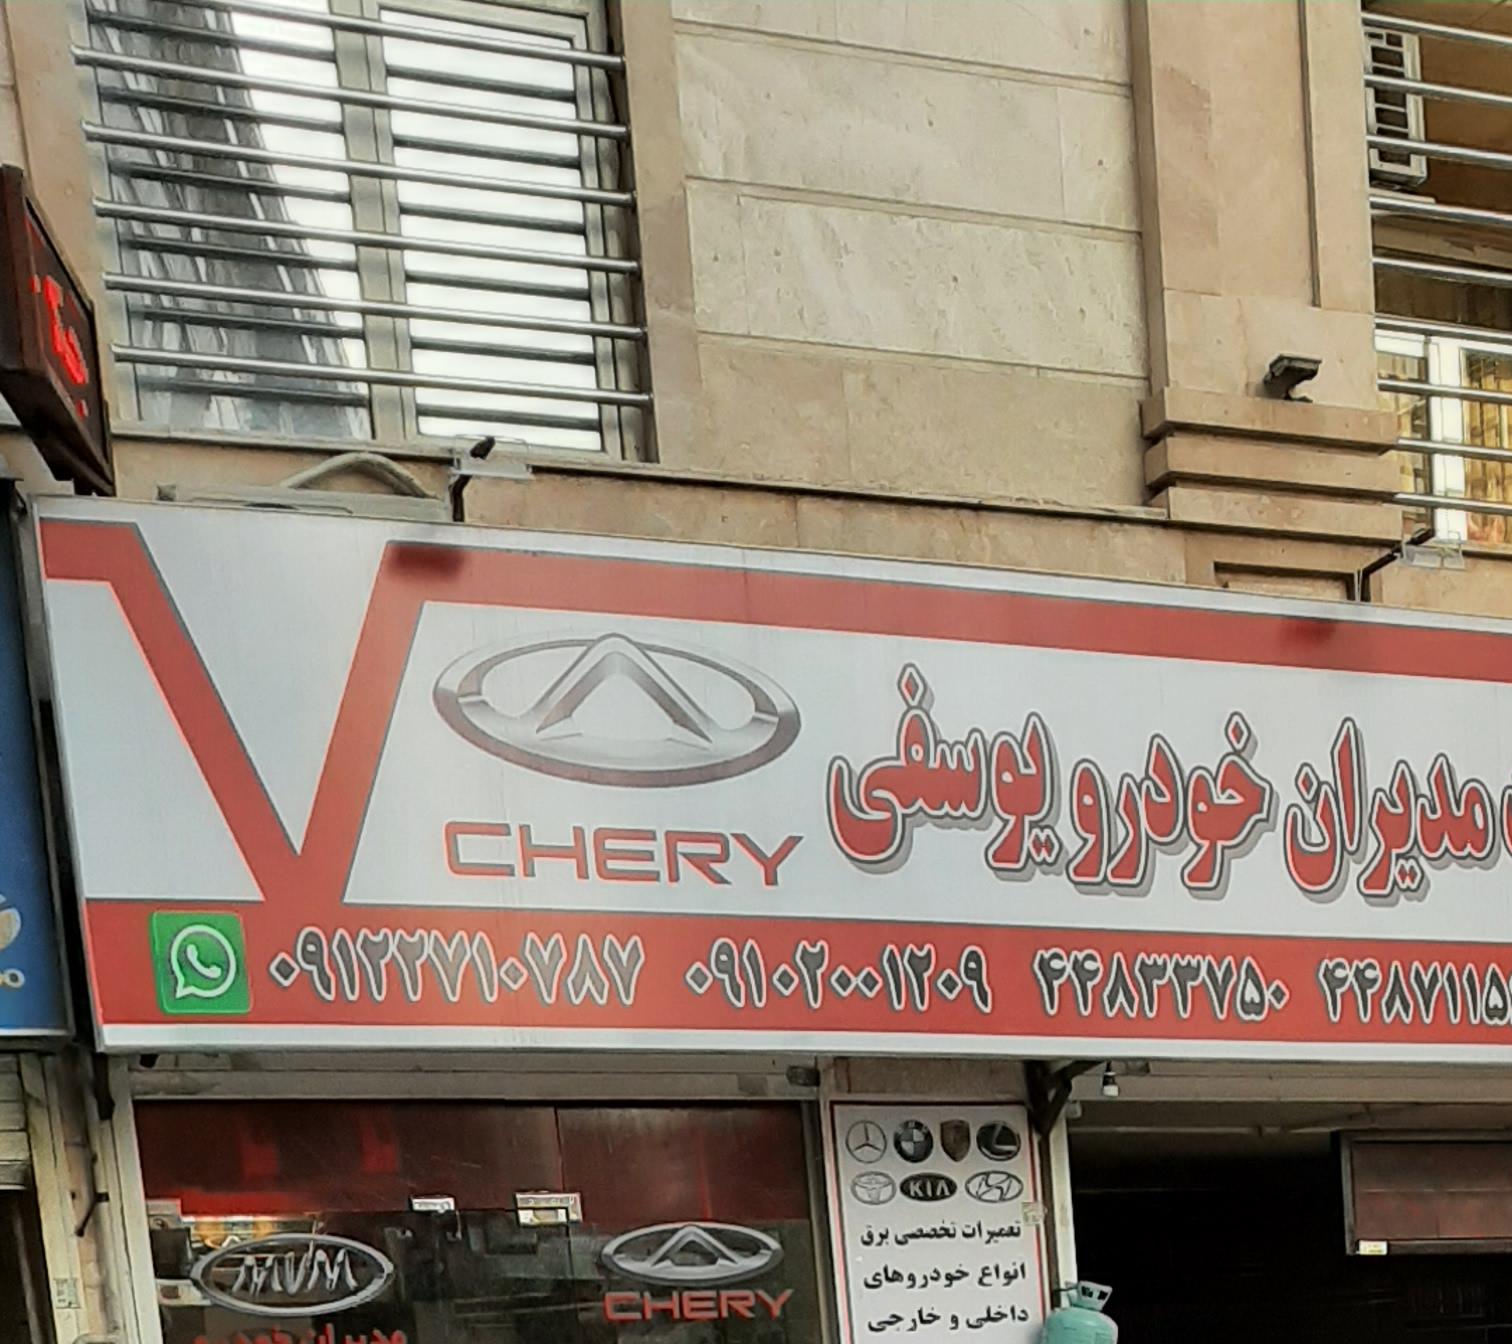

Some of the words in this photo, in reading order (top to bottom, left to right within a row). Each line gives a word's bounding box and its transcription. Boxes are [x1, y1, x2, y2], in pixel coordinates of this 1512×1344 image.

[827, 662, 1060, 868] یوسفی
[1068, 712, 1273, 892] خودرو
[1284, 717, 1496, 898] مدیران
[444, 820, 804, 888] CHERY
[268, 925, 645, 1006] ۰۹۱۲۲۷۱۰۷۸۷
[685, 937, 993, 1014] ۰۹۱۰۲۰۰۱۲۰۹
[1032, 945, 1290, 1021] ۴۴۸۳۳۷۵۰
[909, 1179, 951, 1198] KIA
[860, 1224, 890, 1247] برق
[894, 1219, 957, 1246] تخصصی
[961, 1220, 1022, 1245] تعمیرات
[231, 1249, 358, 1296] MVM
[863, 1263, 971, 1290] خودروهای
[977, 1261, 1027, 1287] انواع
[602, 1289, 794, 1322] CHERY
[965, 1304, 1030, 1330] داخلی
[867, 1306, 942, 1333] خارجی
[949, 1312, 960, 1331] و
